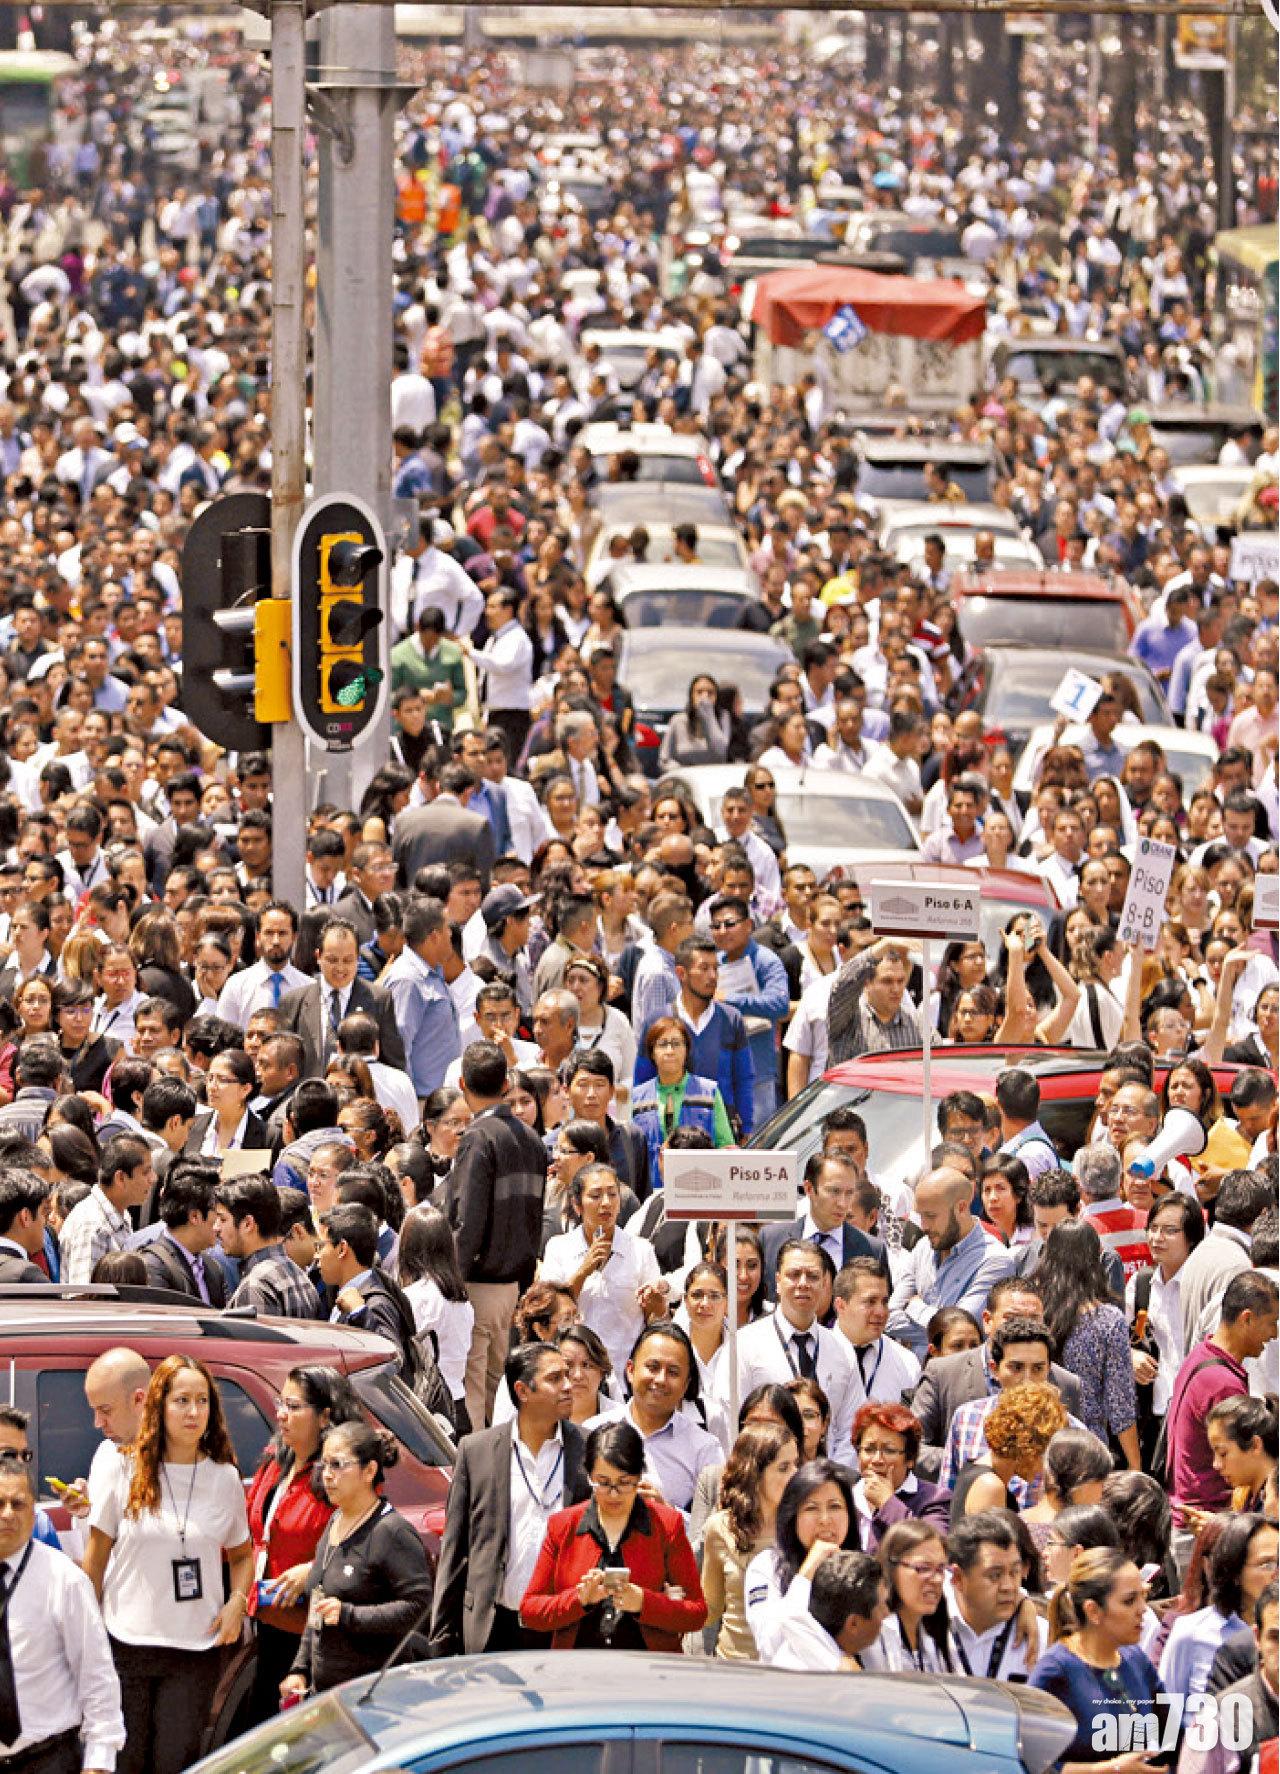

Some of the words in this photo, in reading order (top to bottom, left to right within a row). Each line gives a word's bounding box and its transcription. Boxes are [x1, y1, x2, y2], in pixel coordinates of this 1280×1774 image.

[1064, 684, 1087, 709] 1
[925, 896, 951, 910] Piso
[730, 1165, 760, 1181] Piso
[763, 1166, 789, 1181] 5-A
[732, 1190, 771, 1202] Reforma
